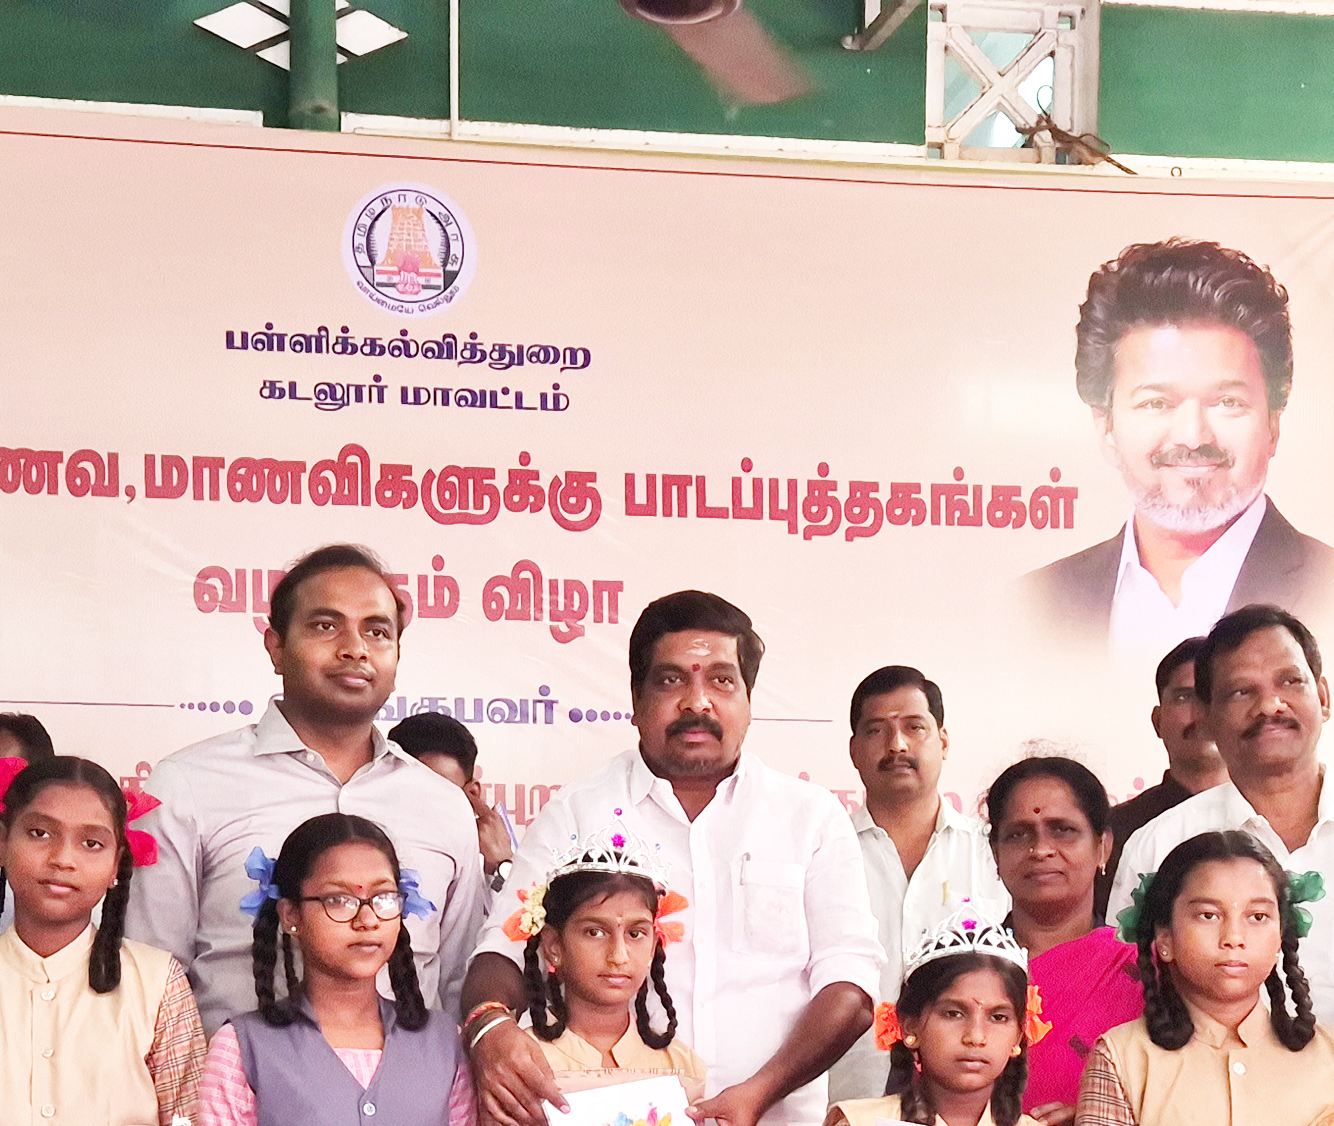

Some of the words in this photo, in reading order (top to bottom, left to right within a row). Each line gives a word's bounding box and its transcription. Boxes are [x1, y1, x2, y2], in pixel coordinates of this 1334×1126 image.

[225, 322, 592, 373] பள்ளிக்கல்வித்துறை
[259, 374, 389, 412] கடலூர்
[400, 383, 570, 413] மாவட்டம்
[624, 457, 1079, 542] பாடப்புத்தகங்கள்
[482, 559, 625, 643] விழா
